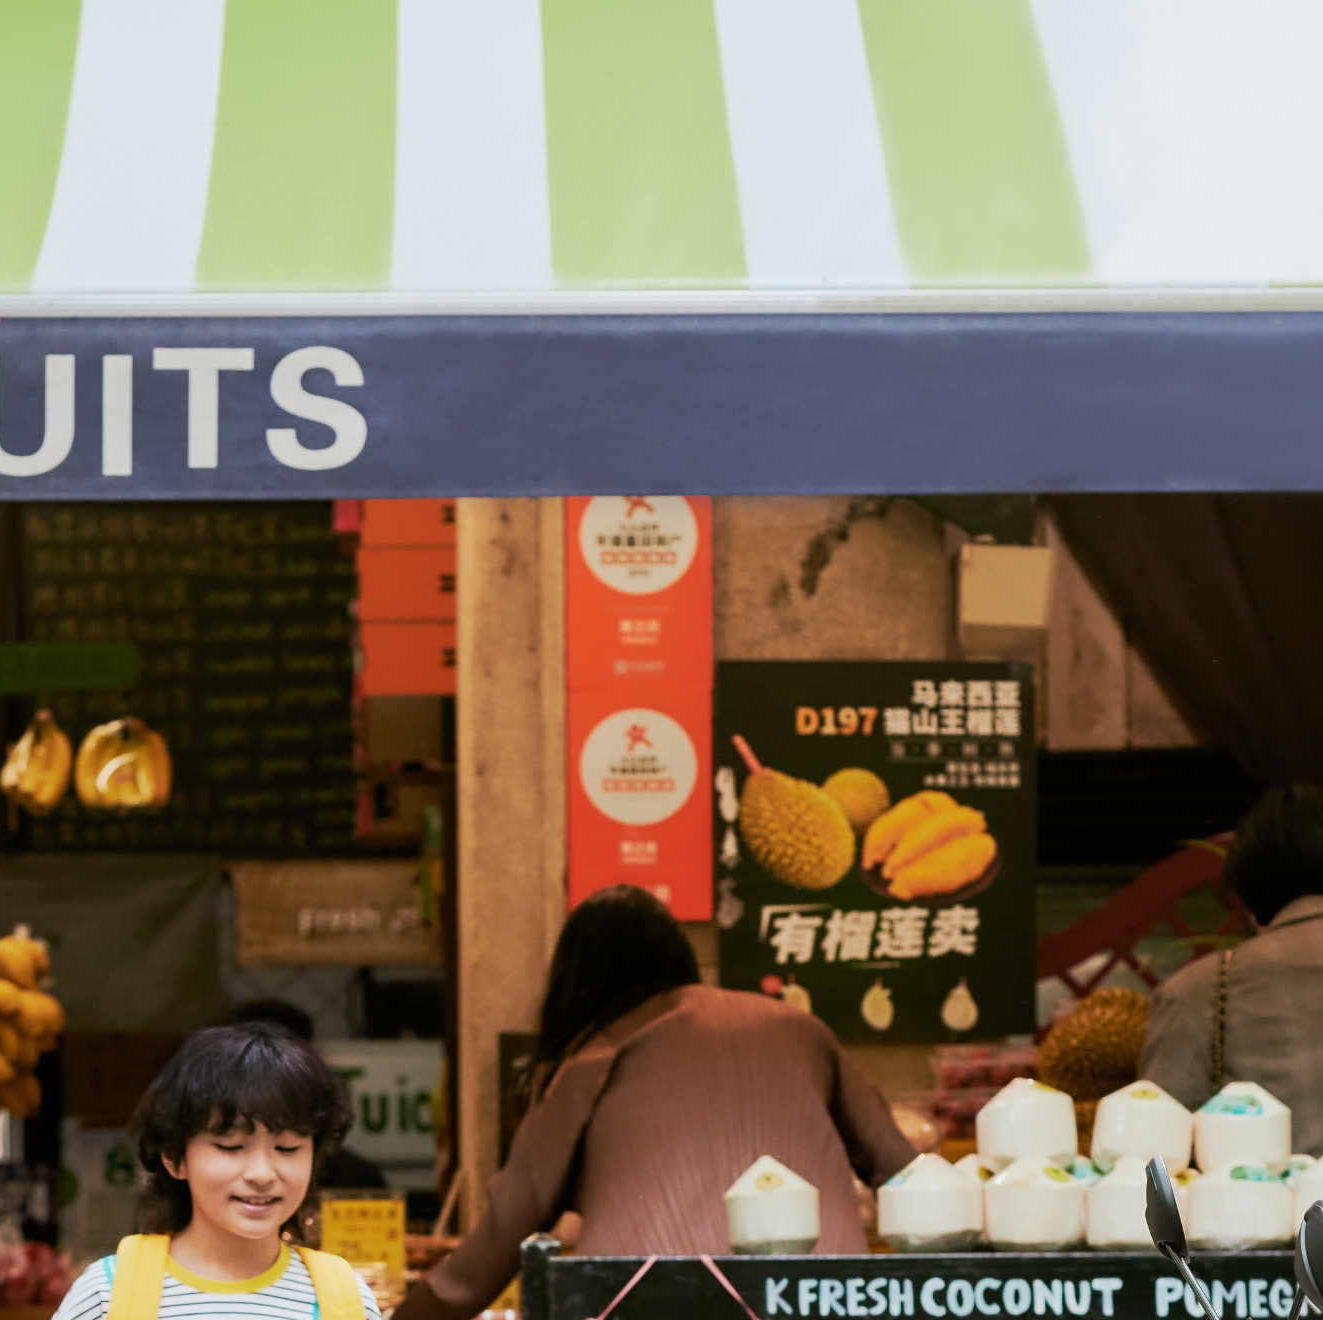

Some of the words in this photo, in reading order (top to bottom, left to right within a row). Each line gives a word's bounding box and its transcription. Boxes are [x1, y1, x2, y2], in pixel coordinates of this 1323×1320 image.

[911, 680, 1021, 708] 马来西亚
[795, 706, 879, 736] D197
[883, 707, 1022, 736] 猫山王榴莲
[771, 904, 980, 964] 有榴莲卖
[765, 1276, 794, 1316] K
[798, 1276, 915, 1317] FRESH
[920, 1276, 1124, 1317] COCONUT
